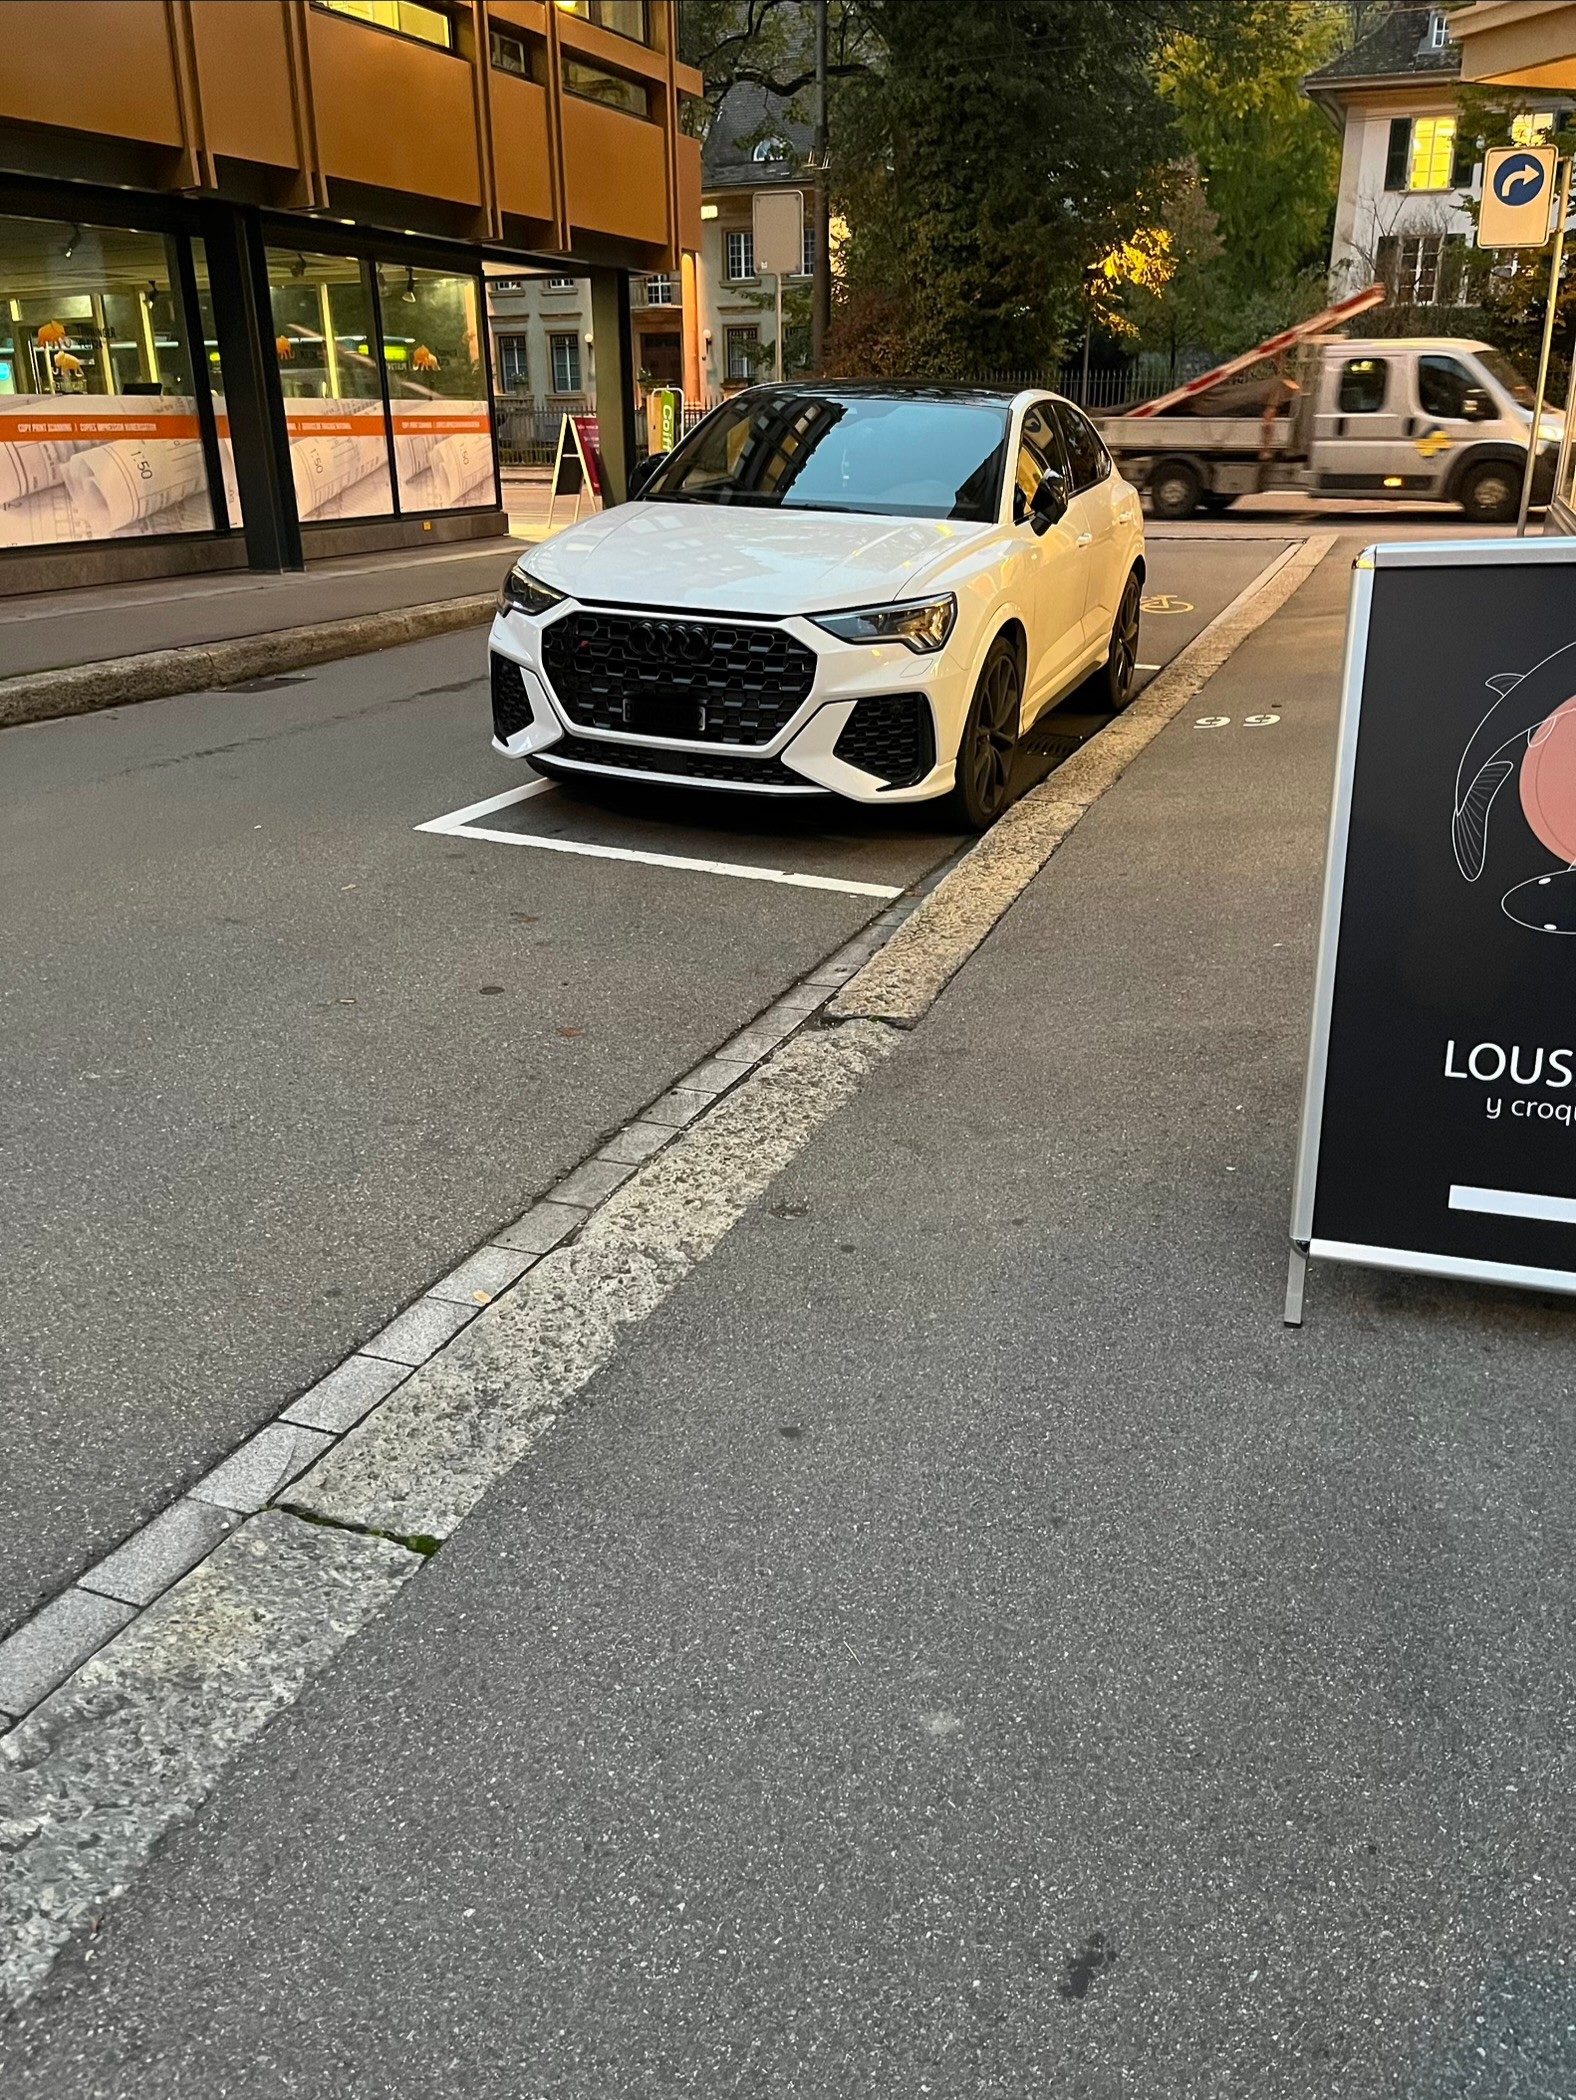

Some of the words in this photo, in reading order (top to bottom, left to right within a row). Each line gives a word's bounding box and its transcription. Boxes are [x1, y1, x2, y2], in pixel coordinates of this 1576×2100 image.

[662, 404, 672, 453] Coiff
[131, 450, 153, 480] 1:50
[1444, 1039, 1576, 1088] LOUS
[1485, 1096, 1502, 1120] y
[1510, 1099, 1576, 1127] croq
